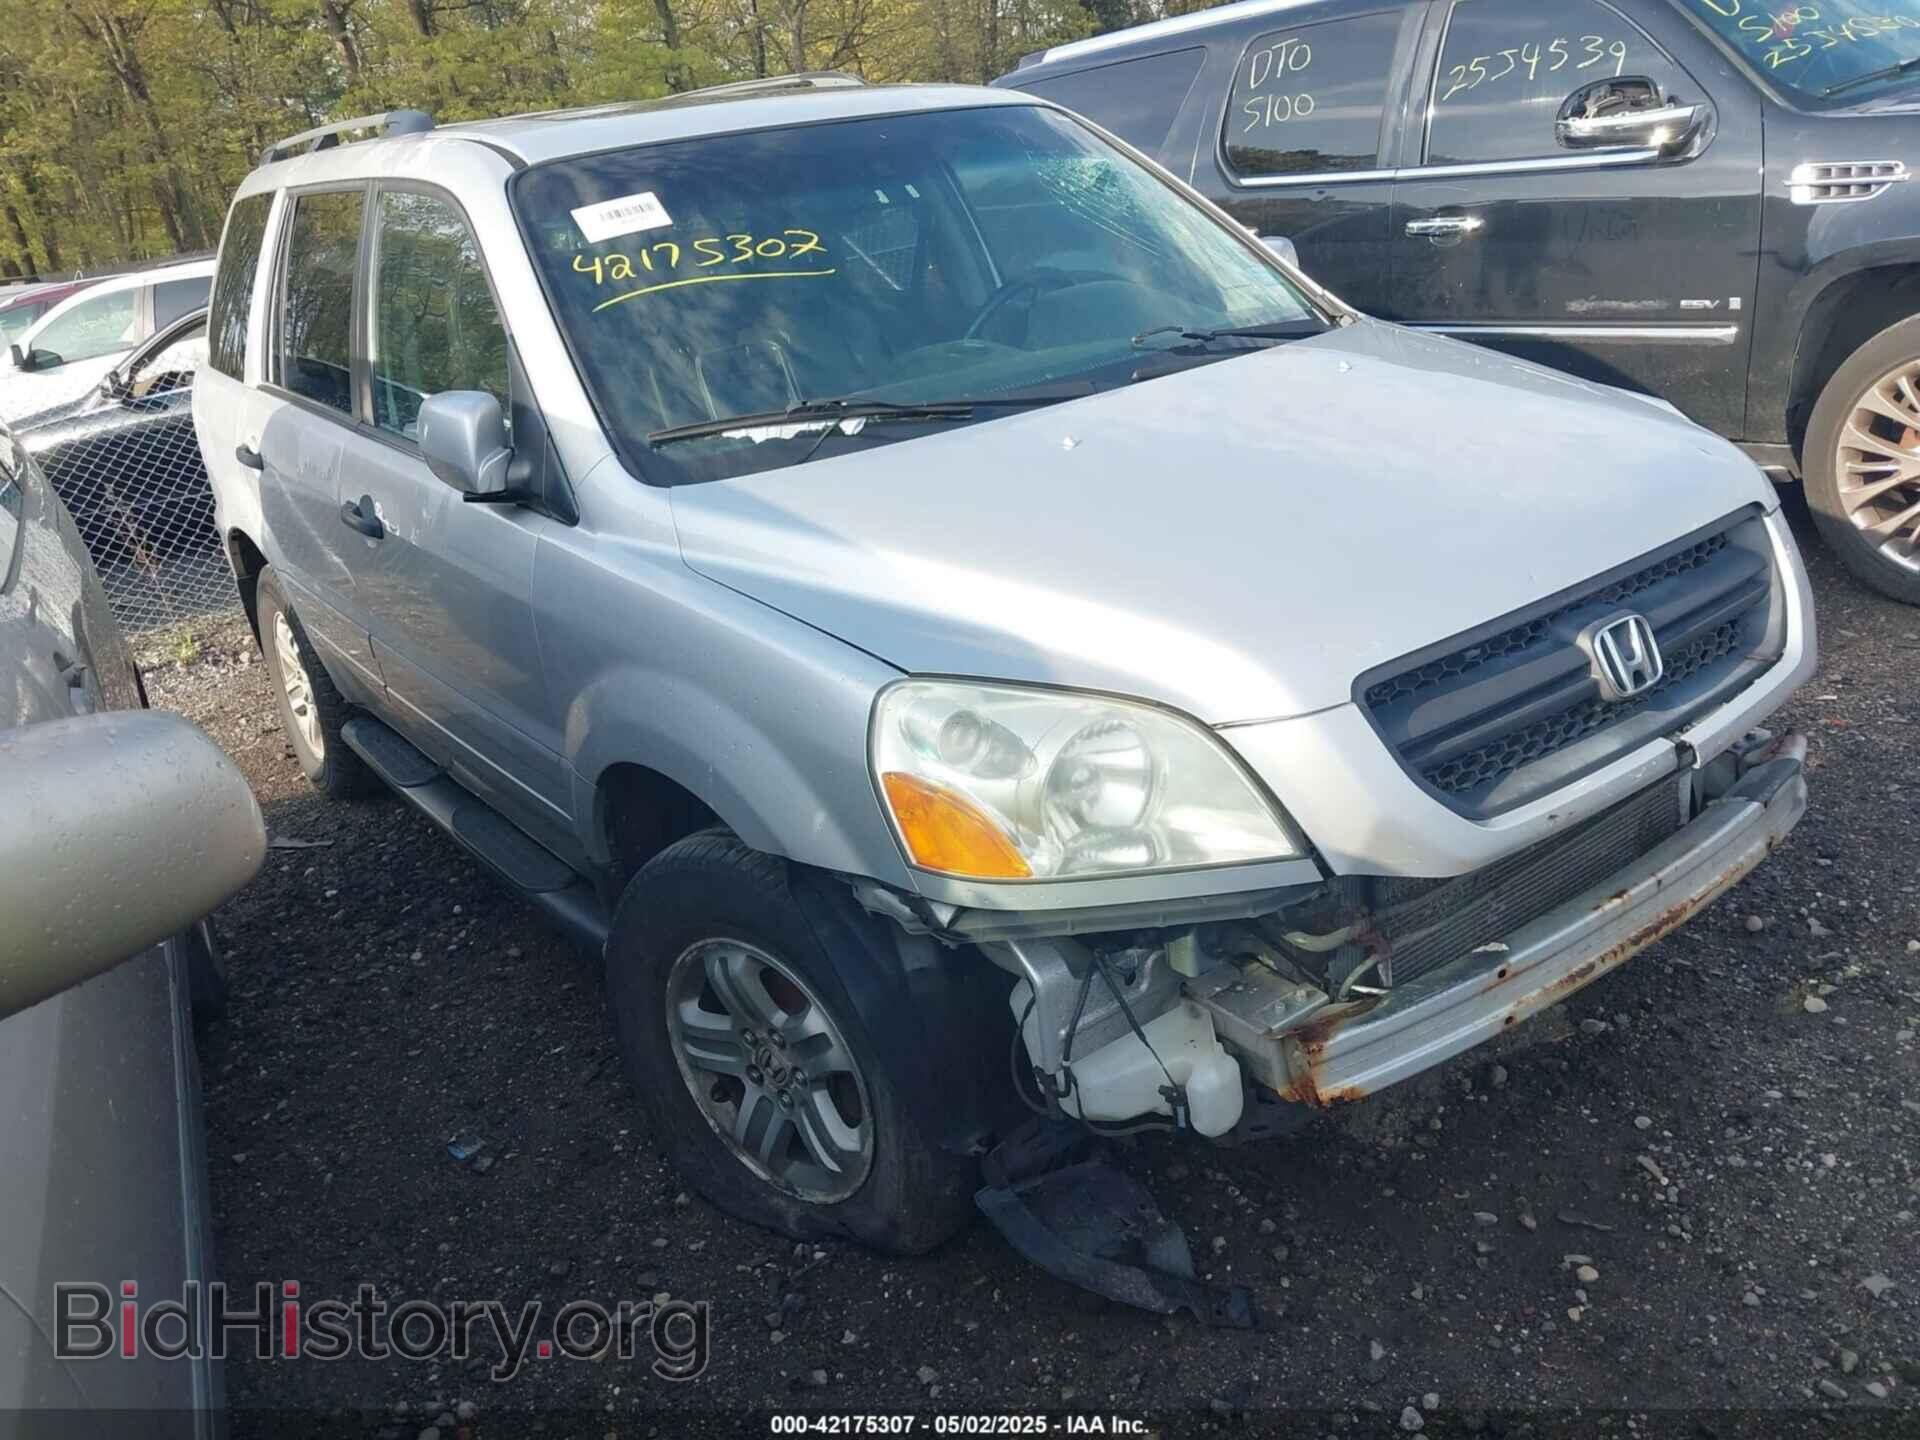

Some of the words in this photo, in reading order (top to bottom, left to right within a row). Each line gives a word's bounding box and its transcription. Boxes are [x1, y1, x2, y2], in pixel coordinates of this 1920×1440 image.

[1249, 37, 1312, 89] DTO
[572, 229, 828, 285] 42175307
[1680, 299, 1721, 310] ESV
